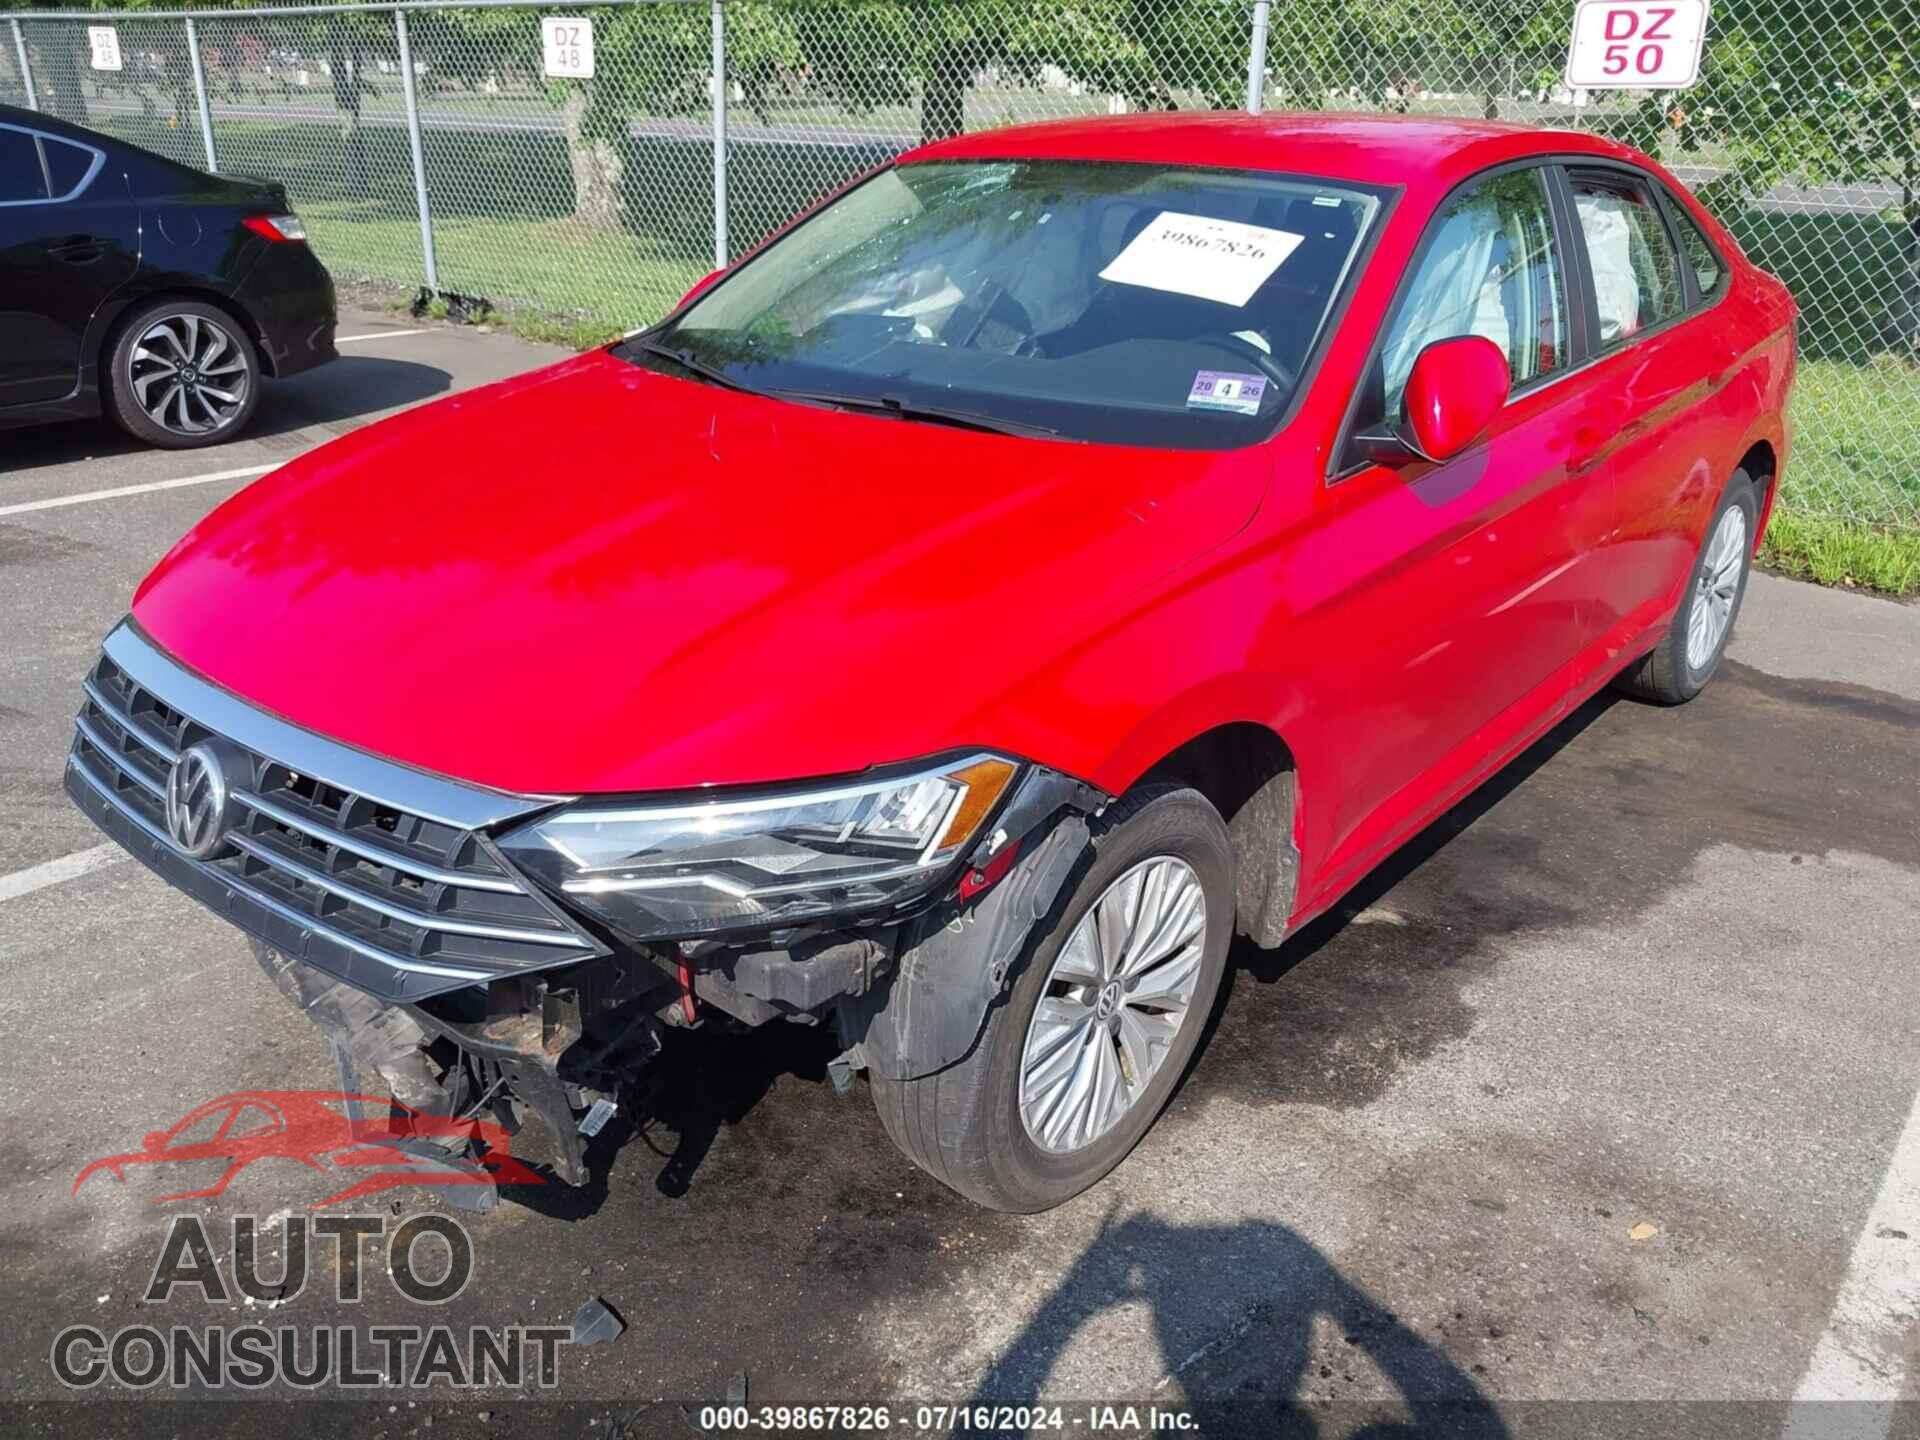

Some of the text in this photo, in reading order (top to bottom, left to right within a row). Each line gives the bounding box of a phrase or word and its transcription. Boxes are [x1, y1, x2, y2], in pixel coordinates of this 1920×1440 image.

[1604, 8, 1675, 40] DZ
[555, 26, 581, 46] DZ
[558, 49, 580, 68] 48
[1602, 44, 1663, 74] 50
[1196, 381, 1259, 396] 20 4 26
